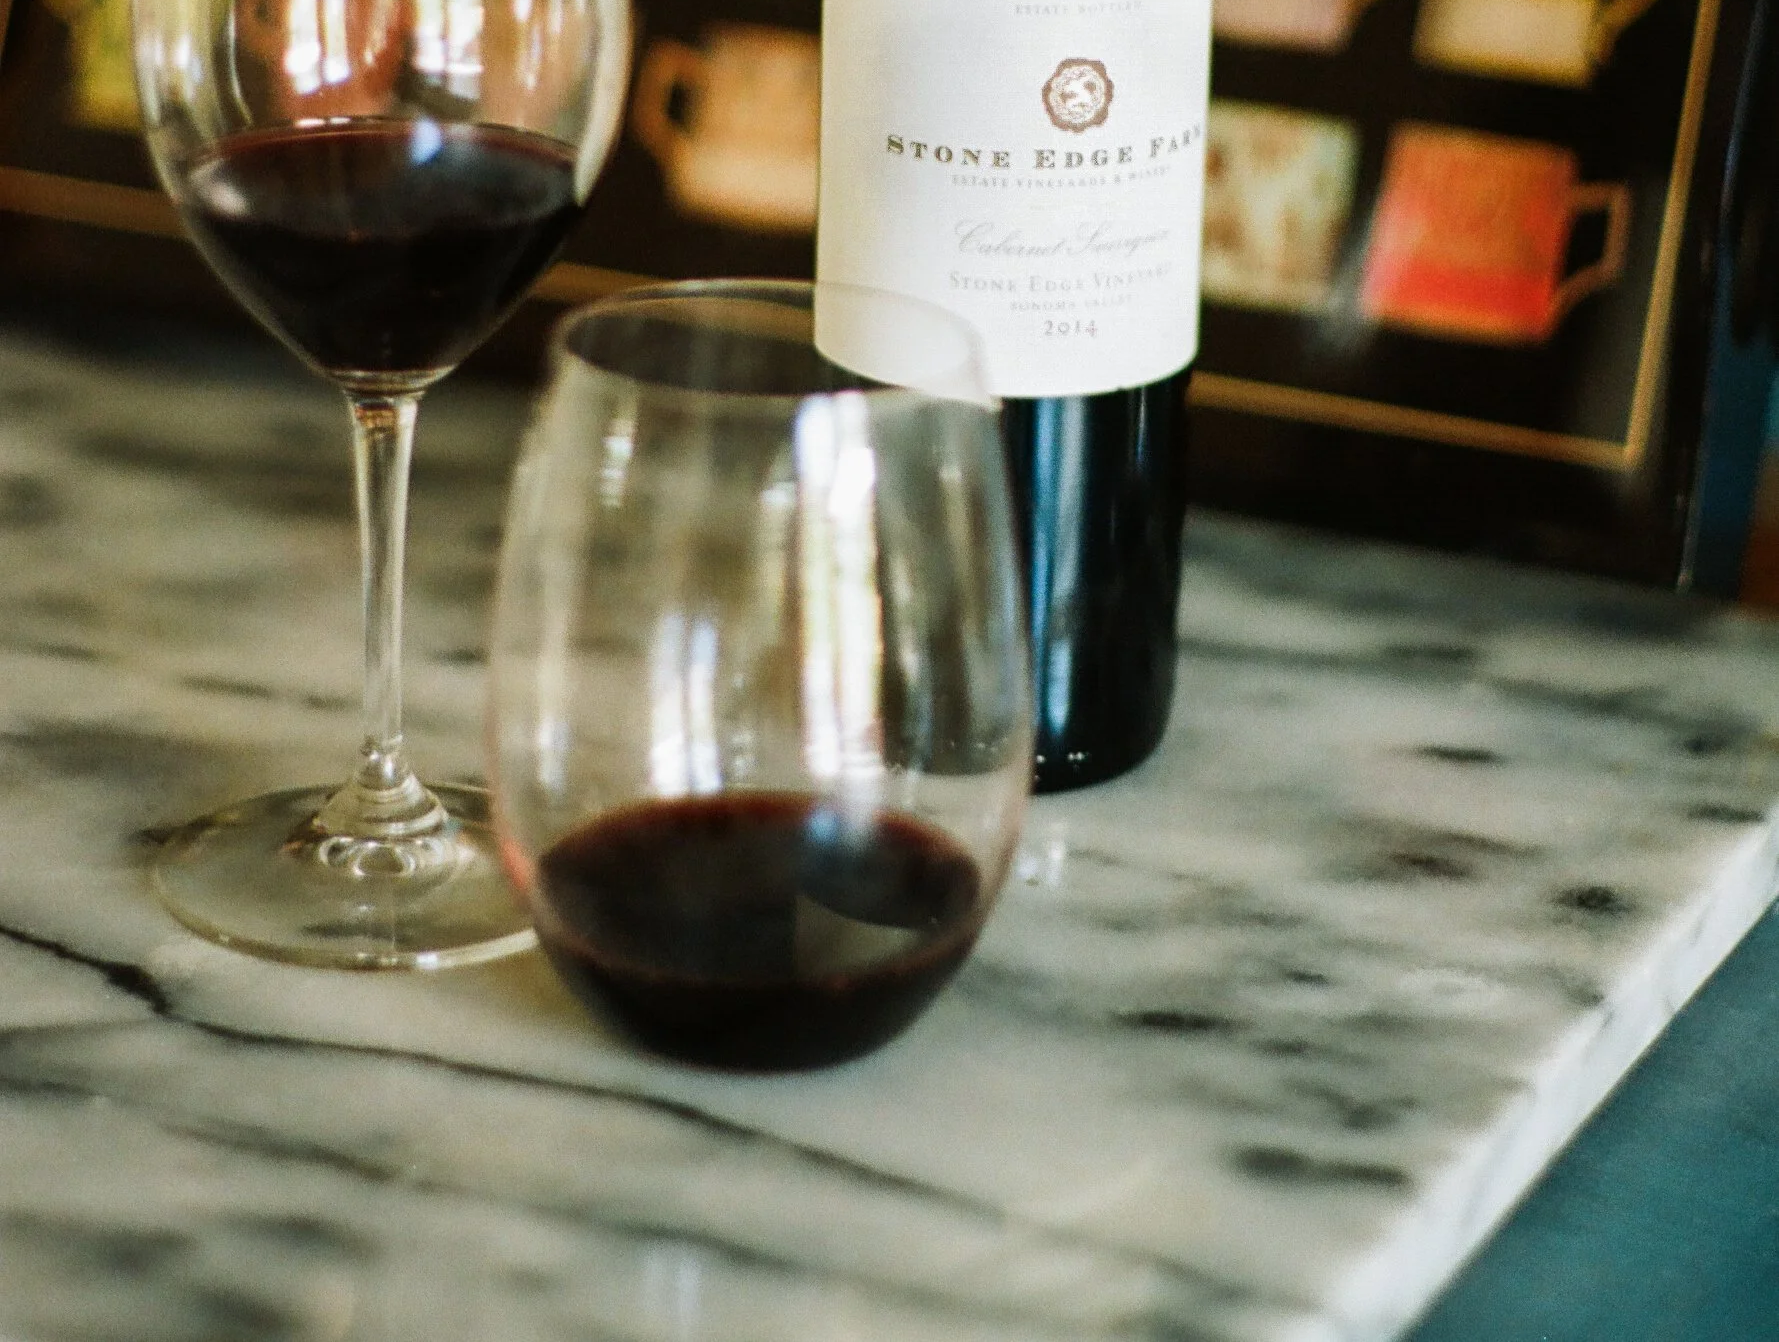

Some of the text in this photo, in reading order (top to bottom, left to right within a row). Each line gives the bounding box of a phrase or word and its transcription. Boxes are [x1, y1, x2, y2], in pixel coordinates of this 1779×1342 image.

[886, 133, 1011, 170] STONE
[1033, 145, 1133, 170] EDGE
[949, 270, 1017, 293] STONE
[1028, 274, 1085, 293] EDGE
[1043, 319, 1098, 339] 2014
